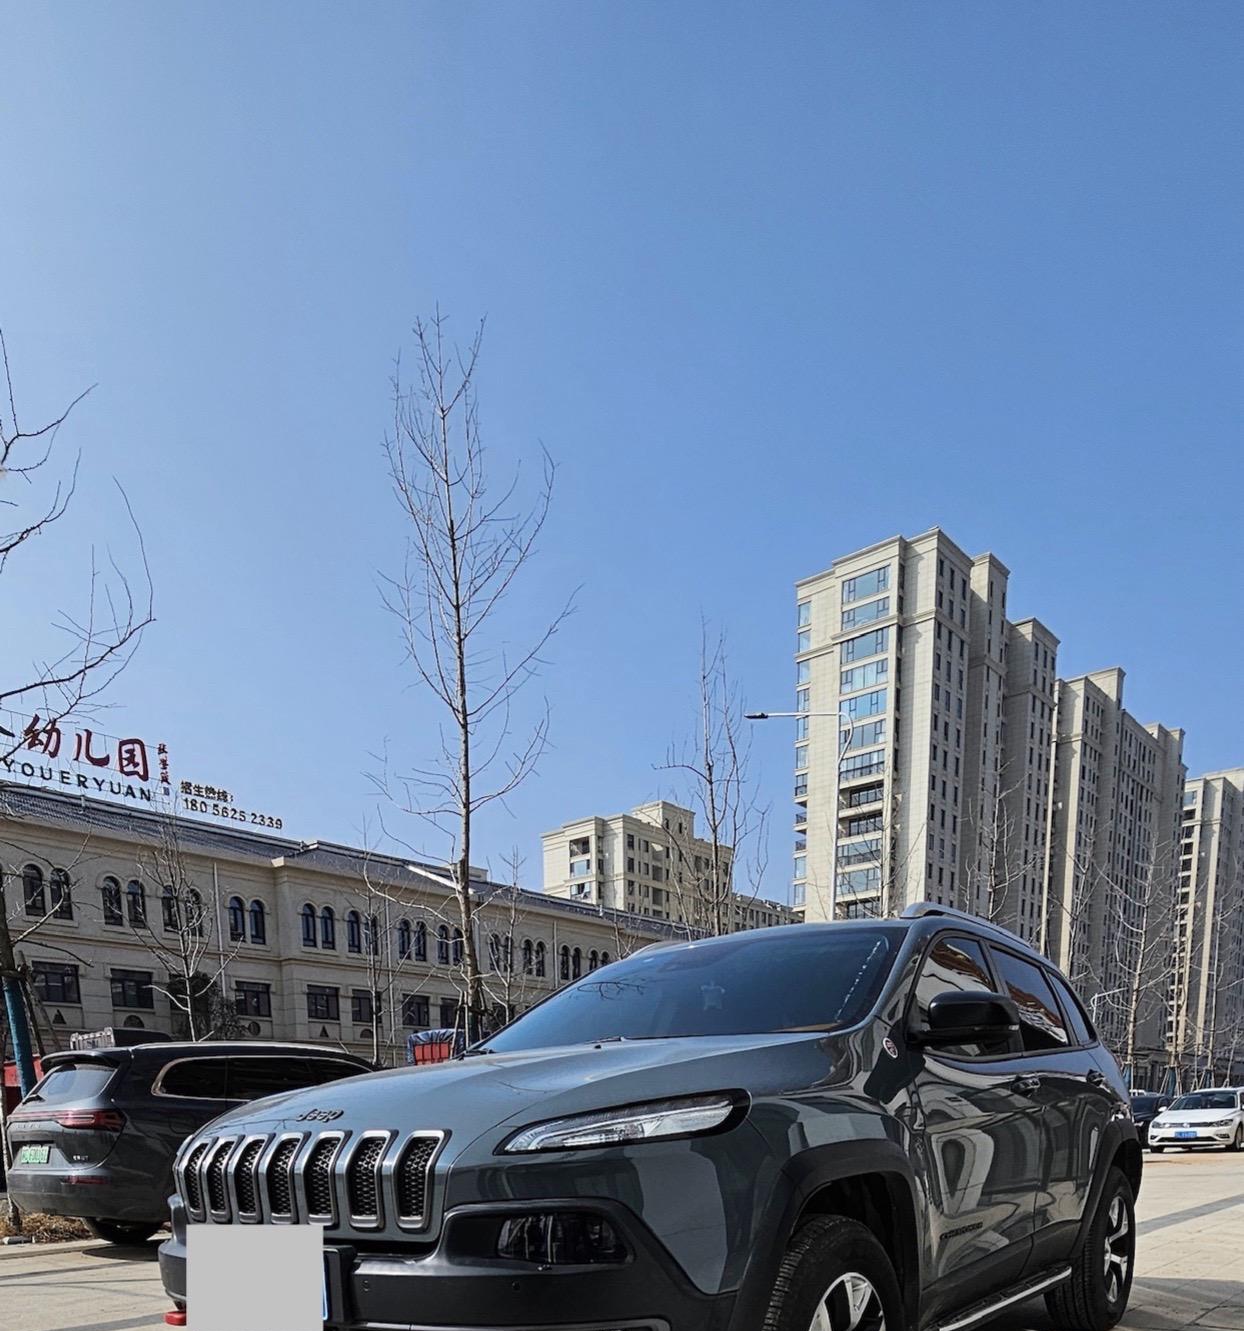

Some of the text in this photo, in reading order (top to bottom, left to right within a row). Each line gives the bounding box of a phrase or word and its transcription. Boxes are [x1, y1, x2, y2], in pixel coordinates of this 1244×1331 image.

[0, 714, 149, 781] 幼儿园
[183, 797, 283, 830] 180 5625 2339
[296, 1108, 345, 1123] Jeep
